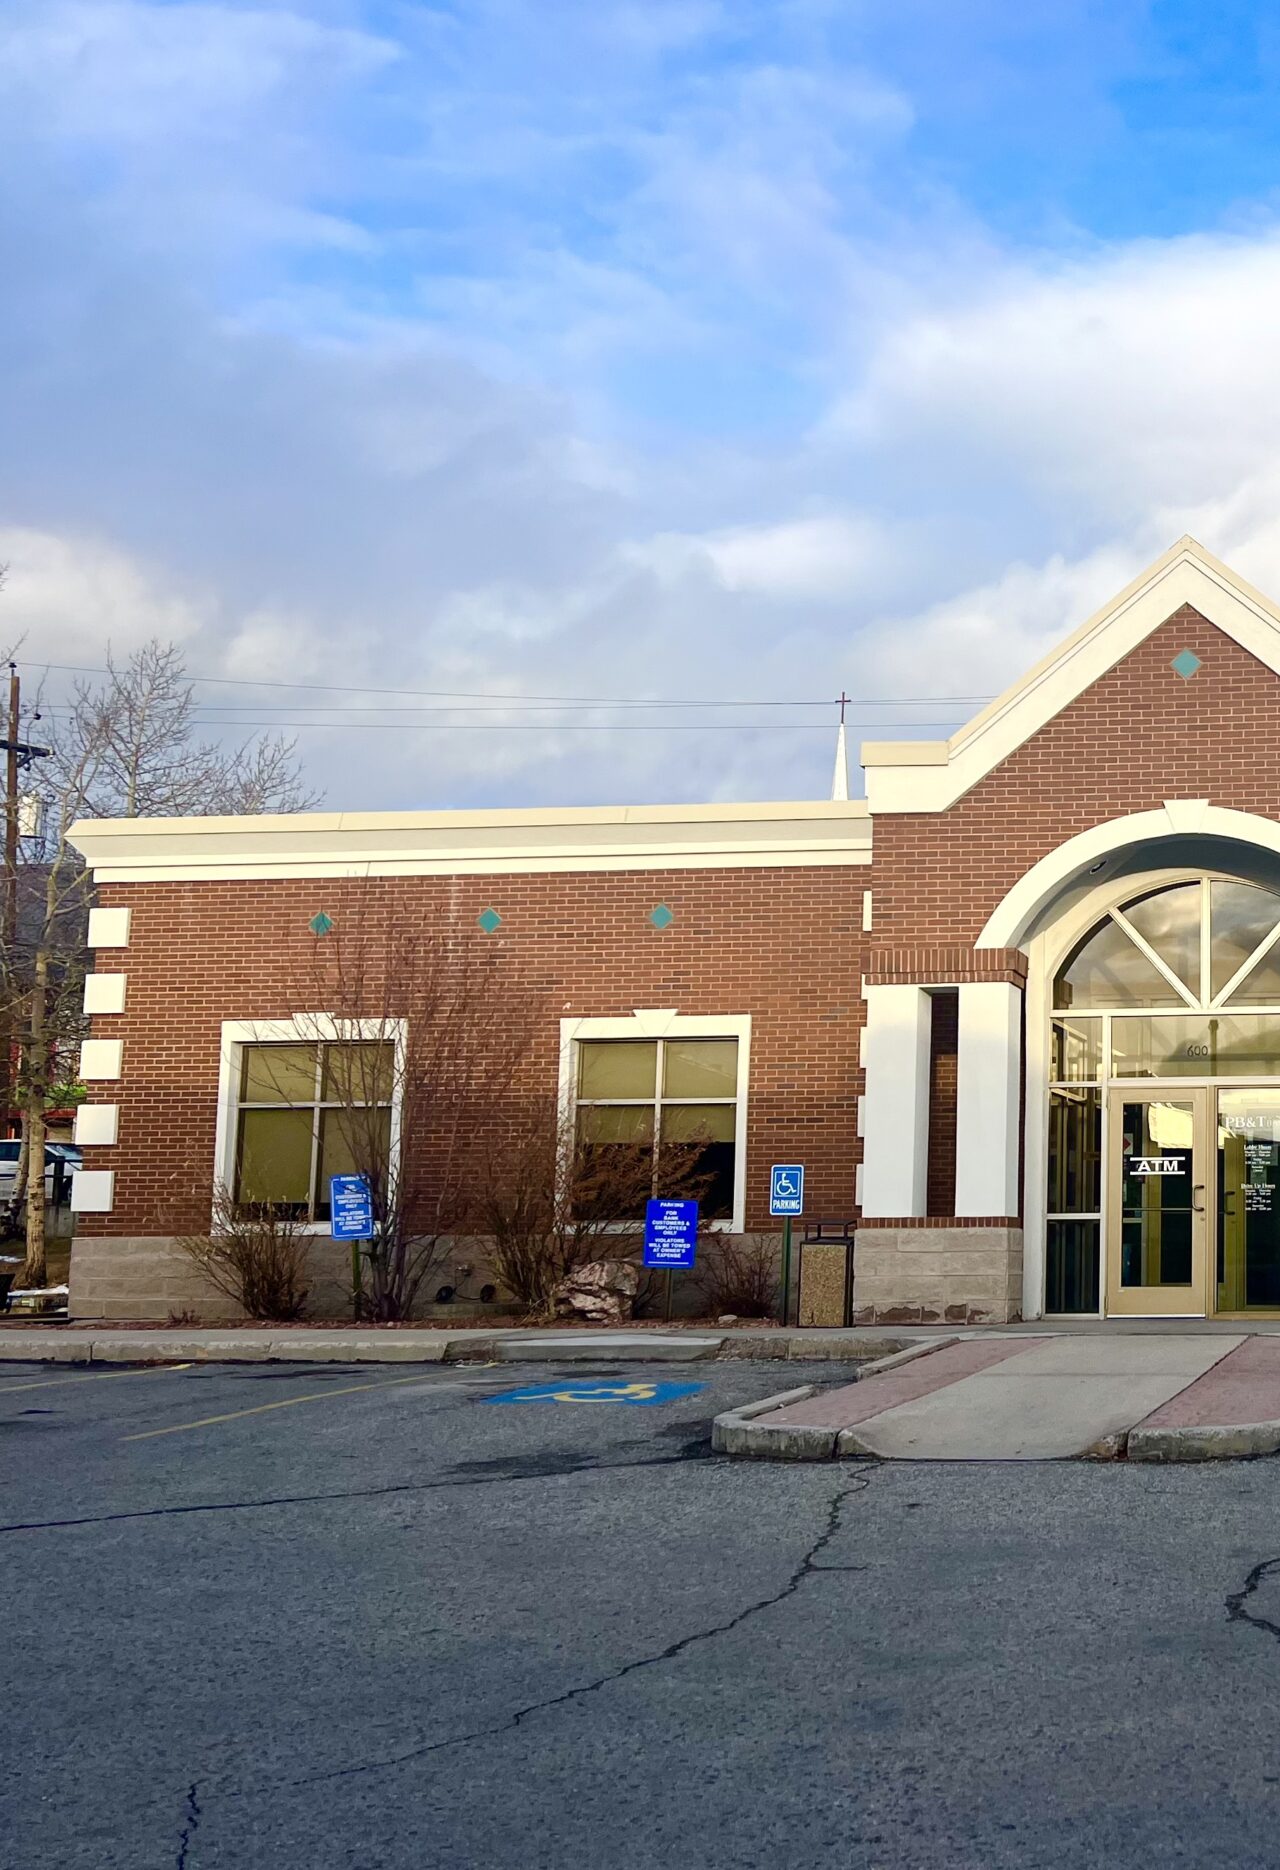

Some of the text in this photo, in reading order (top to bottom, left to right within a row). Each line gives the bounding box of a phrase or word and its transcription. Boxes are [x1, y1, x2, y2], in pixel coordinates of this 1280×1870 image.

[1187, 1044, 1208, 1057] 600
[1225, 1116, 1266, 1128] PB&T
[1138, 1161, 1178, 1171] ATM
[773, 1200, 799, 1209] PARKING
